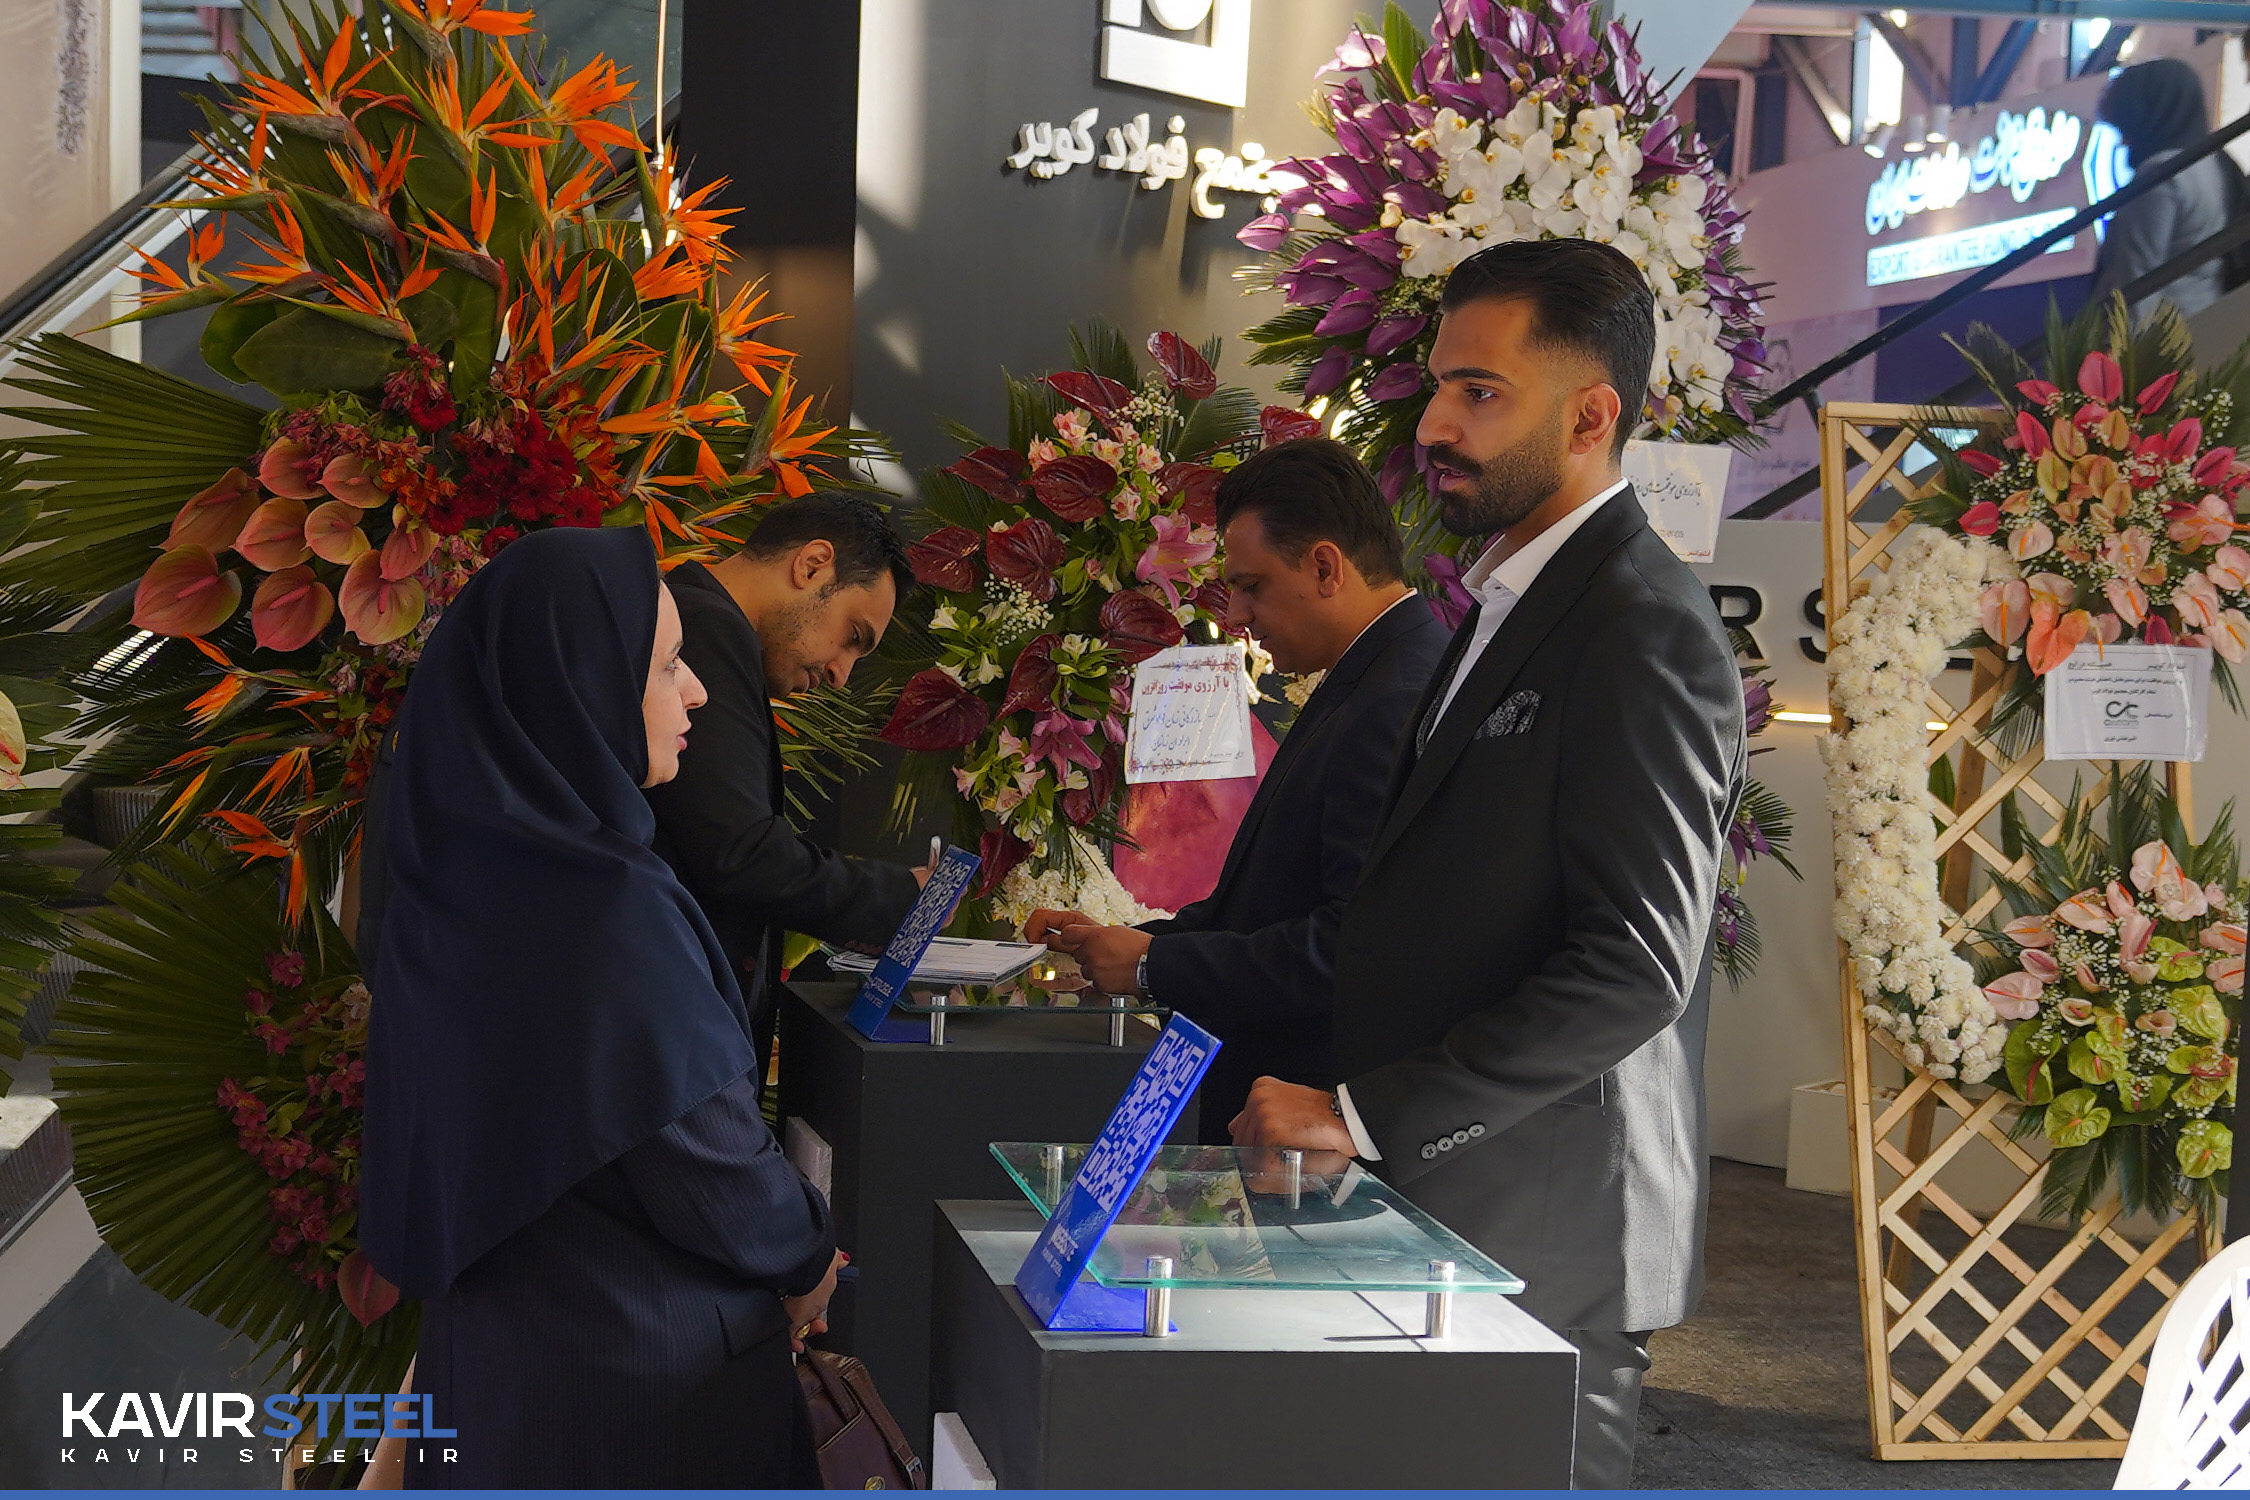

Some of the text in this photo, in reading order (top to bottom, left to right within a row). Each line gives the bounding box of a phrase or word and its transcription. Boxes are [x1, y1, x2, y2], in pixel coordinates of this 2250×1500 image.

[1006, 107, 1098, 179] کویر
[1098, 113, 1188, 190] فولاد
[1194, 675, 1221, 693] آرزوی
